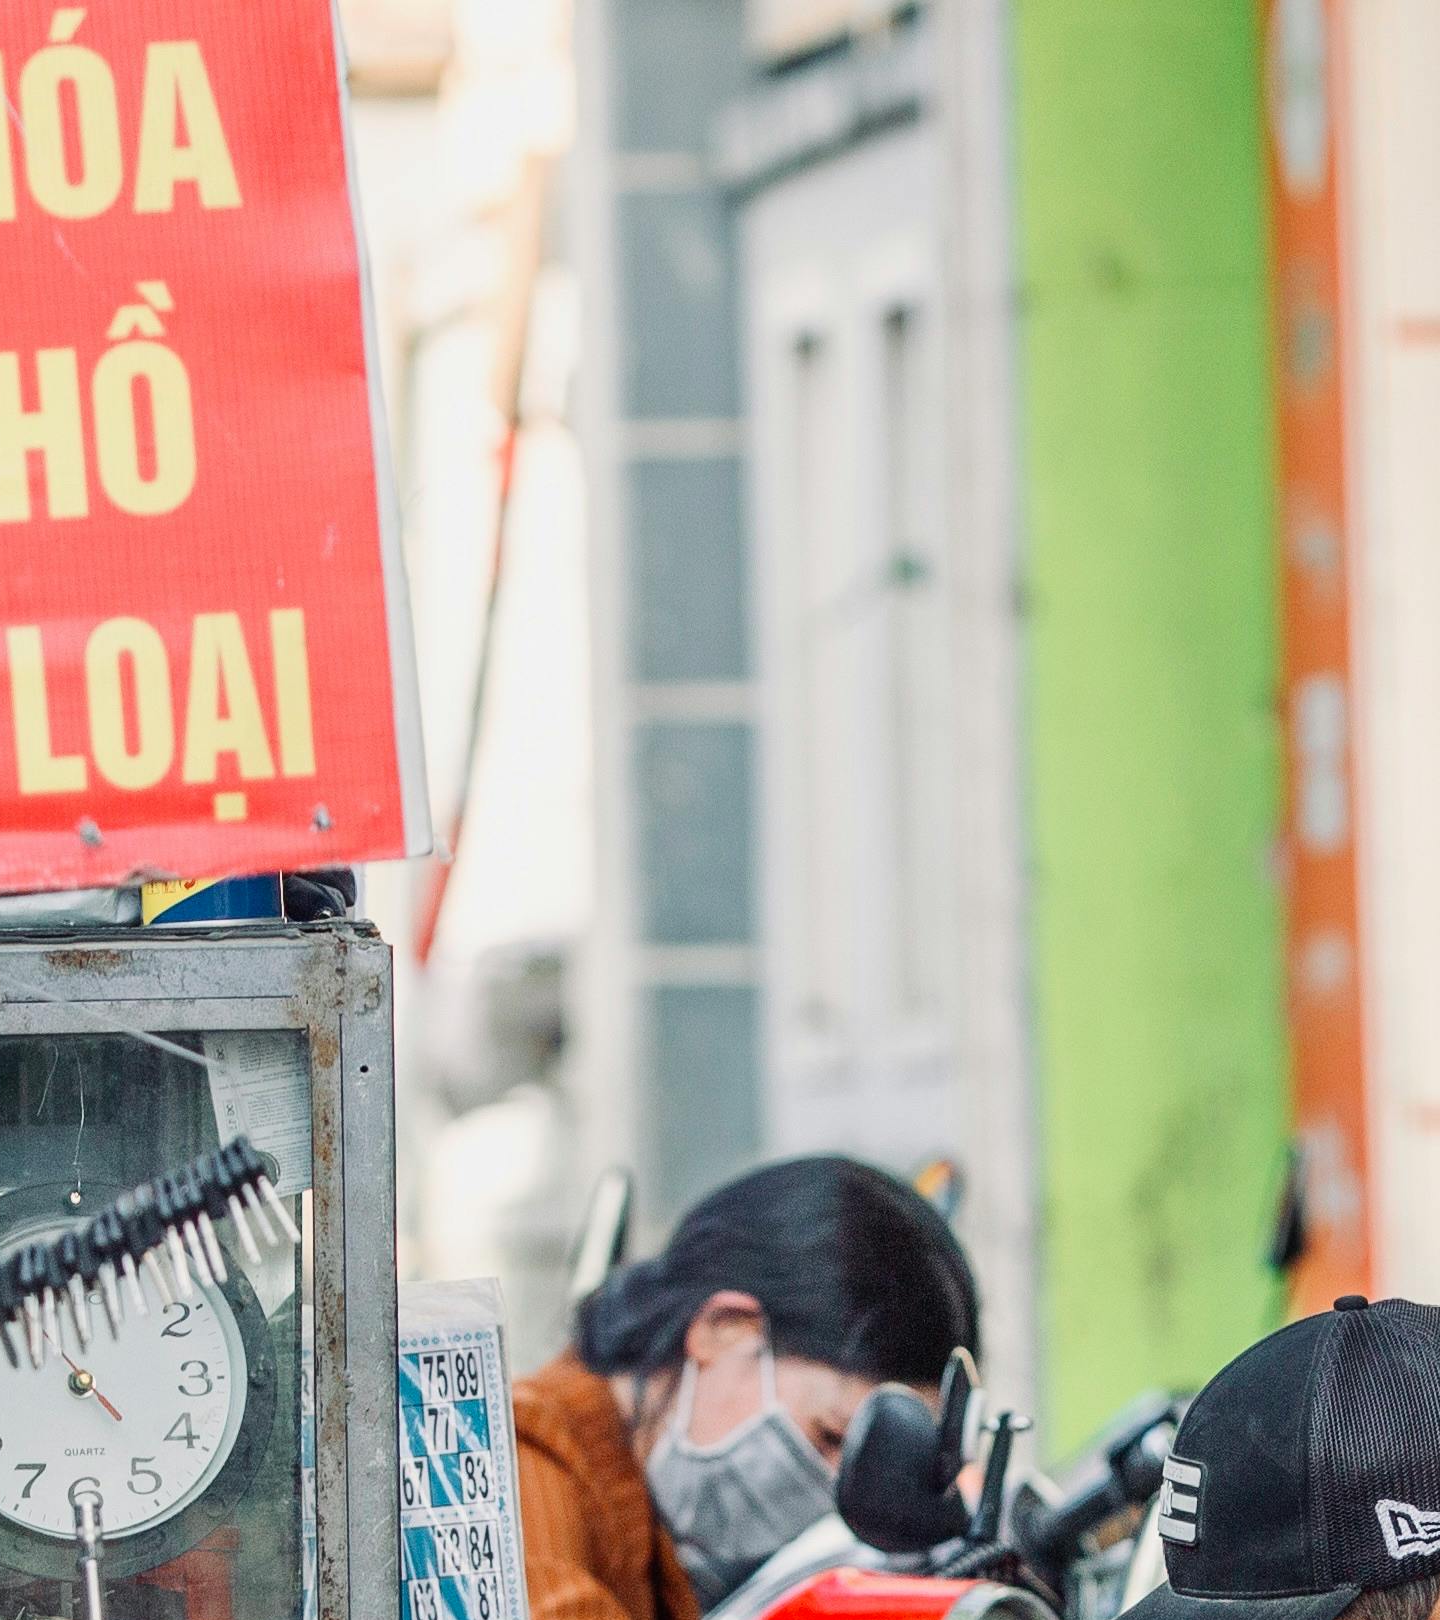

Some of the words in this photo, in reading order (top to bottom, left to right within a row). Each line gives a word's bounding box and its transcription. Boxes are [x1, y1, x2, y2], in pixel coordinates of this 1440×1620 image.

[5, 607, 316, 822] LOẠI
[160, 1301, 193, 1338] 2
[177, 1359, 213, 1397] 3
[423, 1354, 448, 1400] 75
[455, 1351, 479, 1398] 89
[162, 1412, 201, 1449] 4
[427, 1407, 450, 1451] 77
[63, 1447, 106, 1458] QUARTZ
[14, 1462, 47, 1500] 7
[126, 1456, 163, 1495] 5
[402, 1460, 424, 1507] 67
[464, 1455, 489, 1500] 83
[469, 1524, 494, 1571] 84
